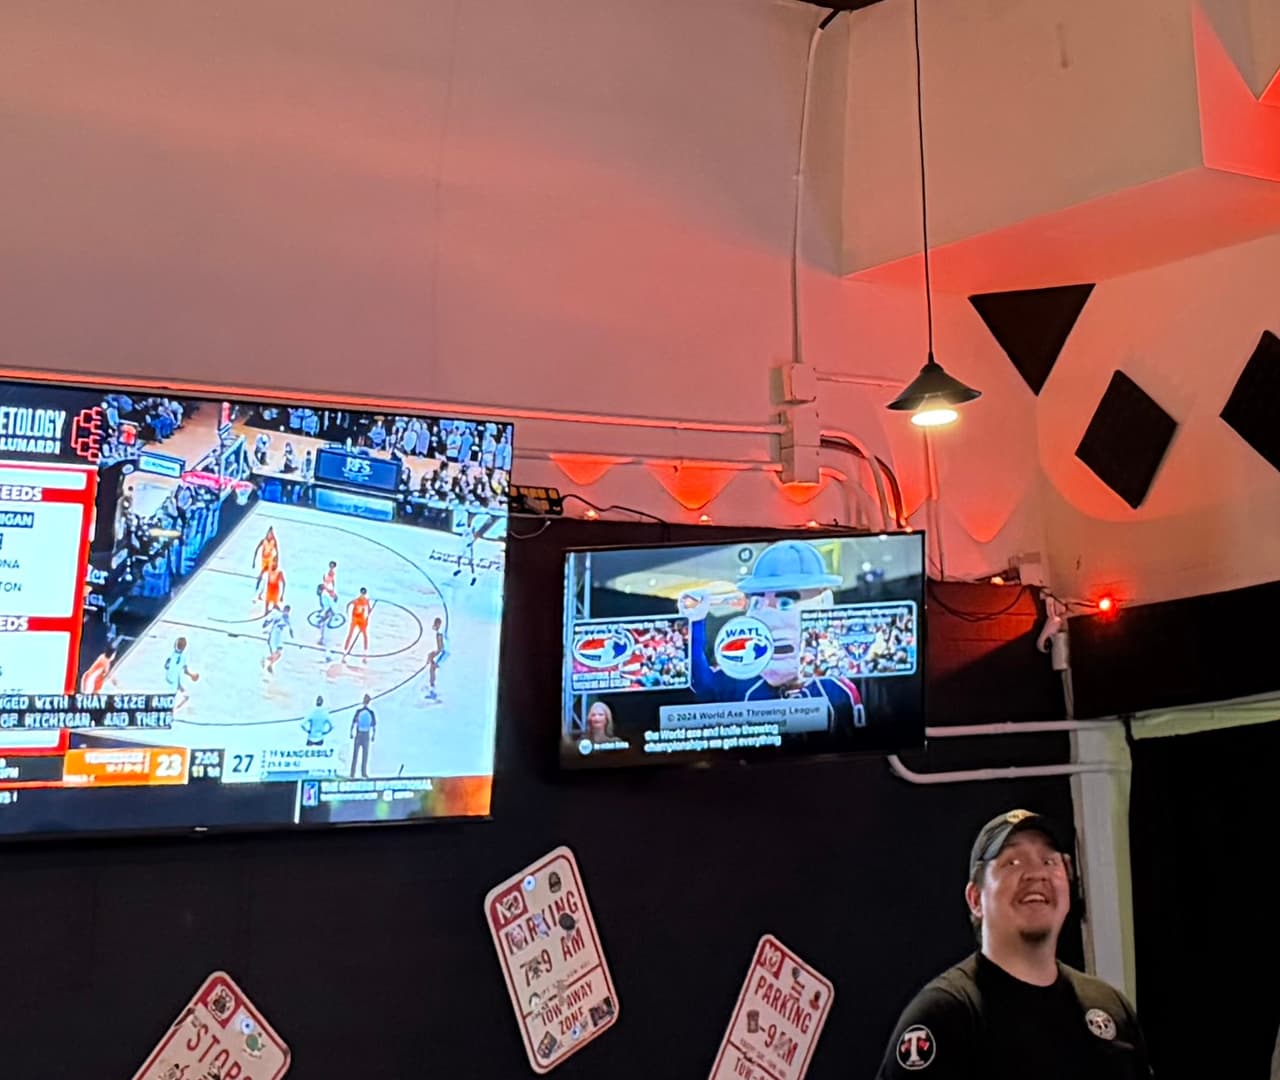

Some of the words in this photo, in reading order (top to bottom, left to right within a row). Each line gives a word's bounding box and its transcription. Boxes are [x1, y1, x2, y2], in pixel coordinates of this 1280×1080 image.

[0, 438, 61, 454] LUNARDI
[725, 627, 762, 638] WATL
[35, 697, 69, 709] WITH
[76, 697, 107, 709] THAT
[113, 696, 145, 709] SIZE
[152, 696, 174, 708] AND
[0, 714, 18, 728] OF
[103, 712, 129, 727] AND
[700, 710, 726, 721] World
[727, 710, 743, 719] Axe
[747, 707, 786, 719] Throwing
[789, 705, 820, 716] League
[280, 749, 334, 758] VANDERBILT
[156, 754, 182, 777] 23
[232, 754, 254, 773] 27
[504, 891, 580, 955] RKING
[754, 977, 812, 1035] PARKING
